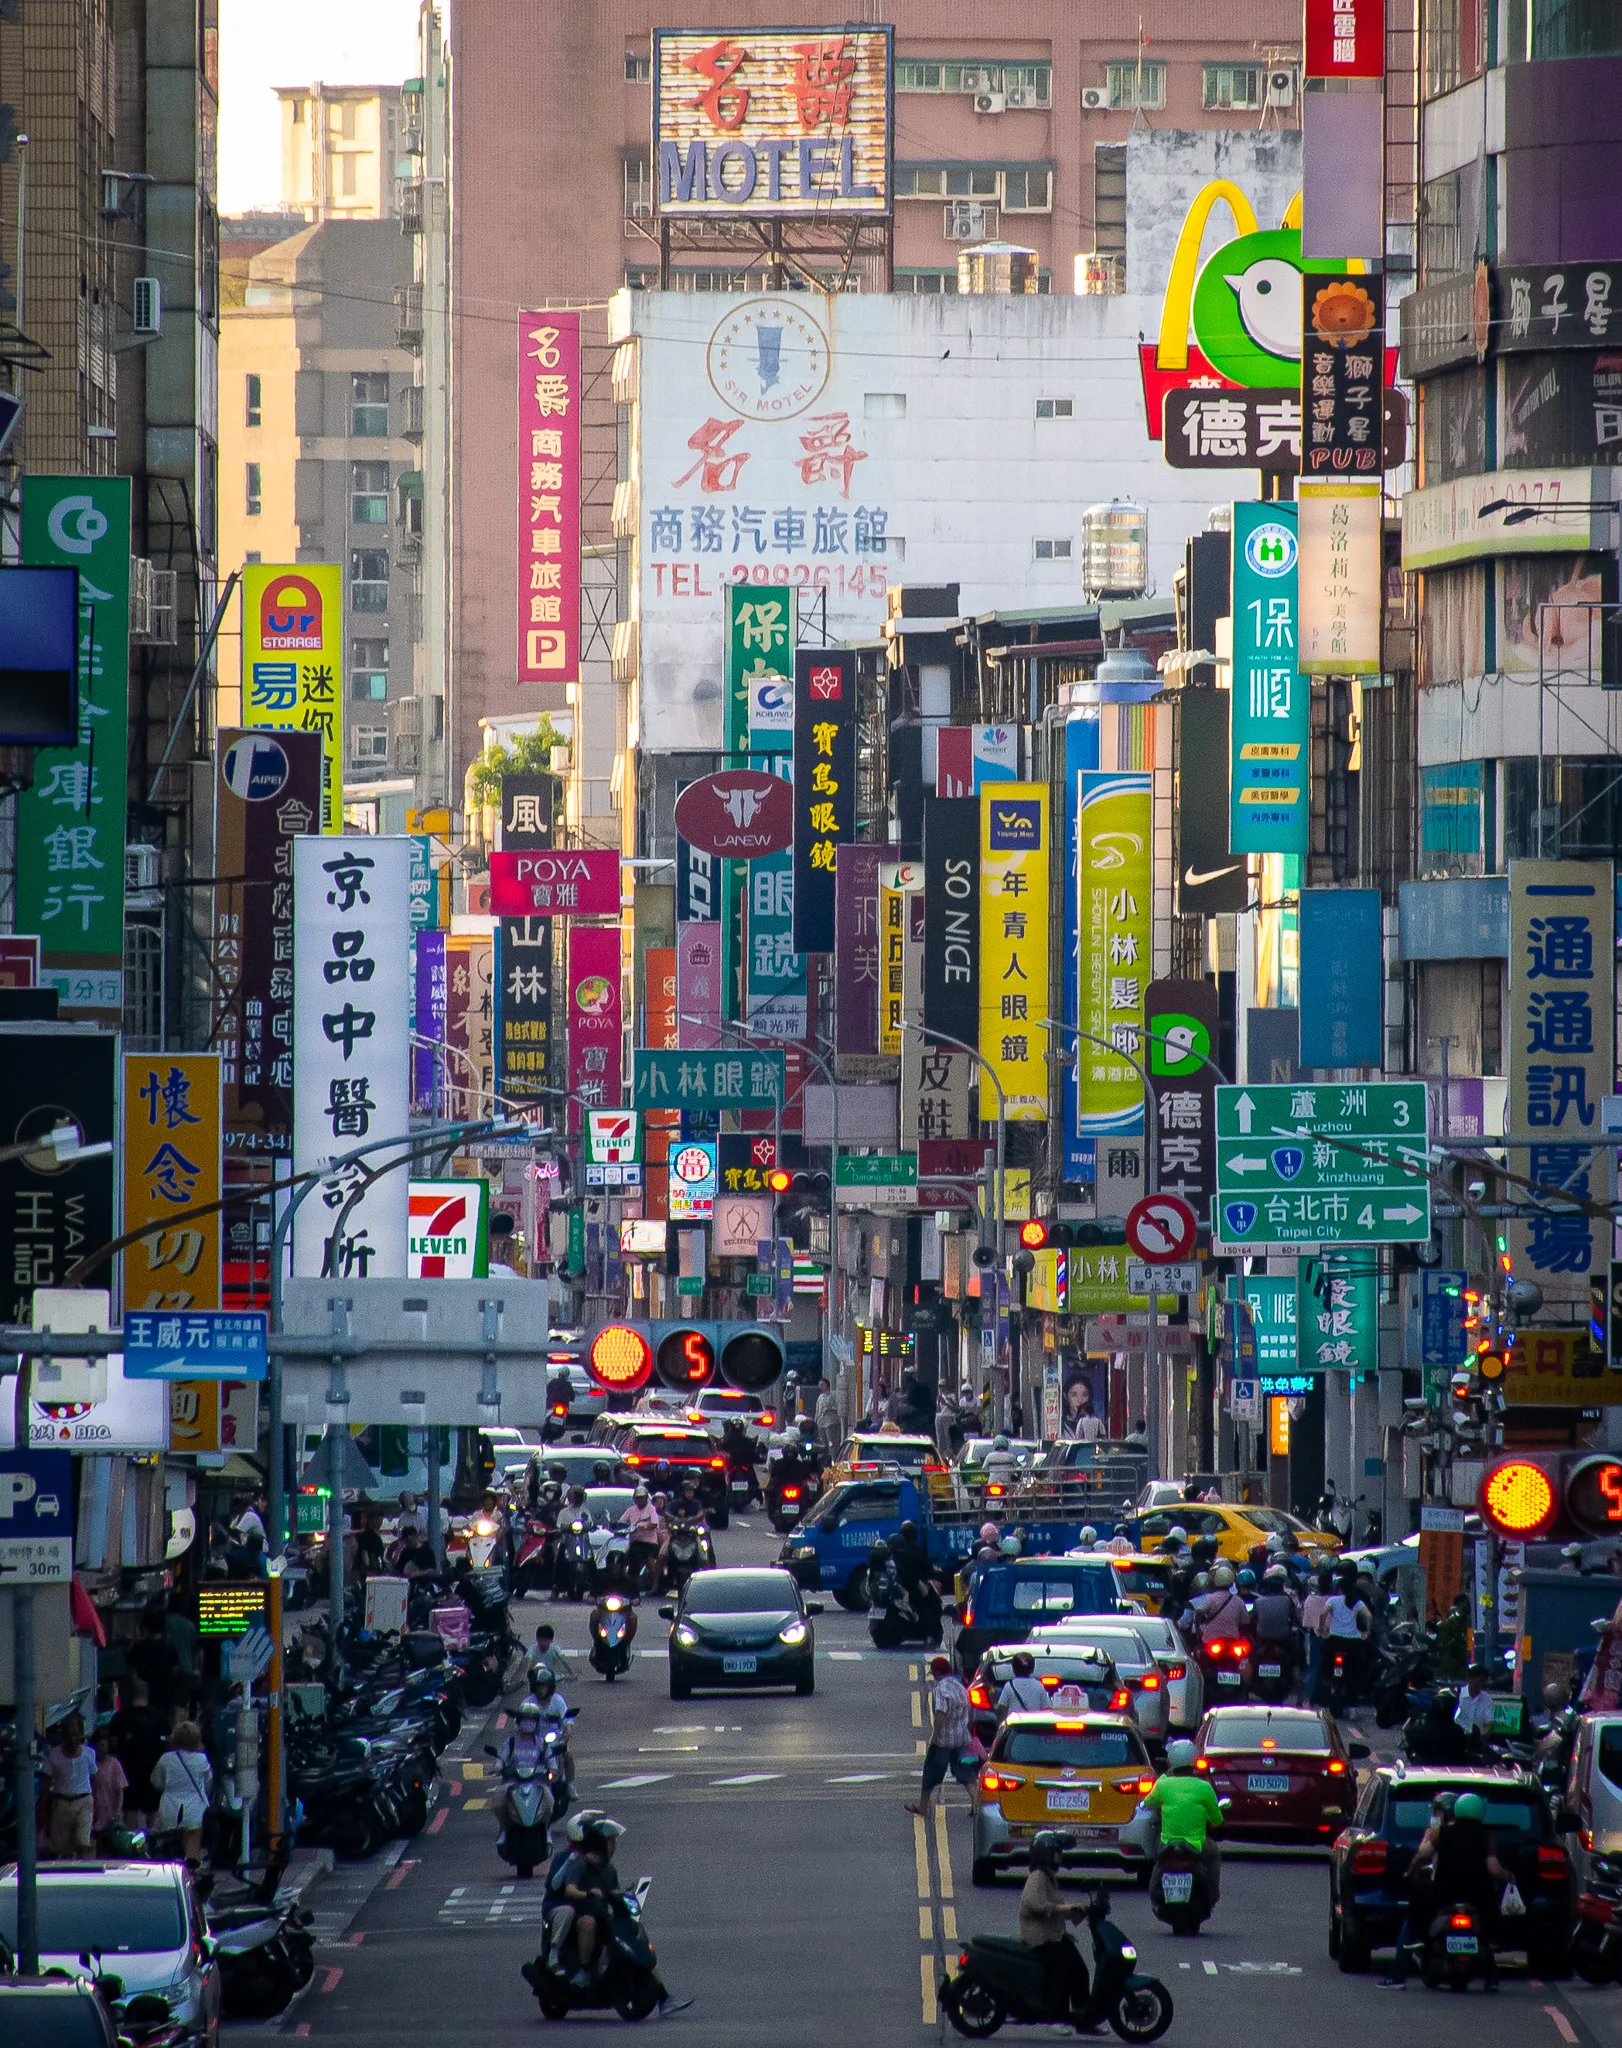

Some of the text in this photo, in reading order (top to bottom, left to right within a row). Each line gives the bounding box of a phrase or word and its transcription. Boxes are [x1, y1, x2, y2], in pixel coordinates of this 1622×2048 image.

[660, 137, 876, 203] MOTEL
[1509, 271, 1613, 340] 獅子星
[722, 379, 815, 412] SIR MOTEL
[1311, 352, 1336, 443] 音樂運動
[1344, 355, 1374, 441] 獅子星
[1181, 398, 1302, 458] 德克
[526, 326, 572, 623] 名爵商務汽車旅館
[1309, 447, 1377, 470] PUB
[650, 504, 889, 554] 商務汽車旅館
[262, 636, 323, 649] STORAGE
[808, 721, 841, 872] 寶島眼鏡
[713, 834, 771, 848] LANEW
[516, 857, 591, 881] POYA
[506, 795, 548, 1004] 風山林
[945, 858, 971, 985] SO NICE
[1000, 869, 1029, 1063] 年青人眼鏡
[1109, 887, 1140, 1056] 小林髮廊
[578, 1017, 614, 1029] POYA
[321, 851, 376, 1279] 京品中醫診所
[637, 1061, 783, 1098] 小林眼鏡
[1290, 1089, 1367, 1118] 蘆洲
[1393, 1100, 1410, 1127] 3
[1306, 1121, 1352, 1132] Luzhou
[1317, 1173, 1384, 1184] Xinzhuang
[1264, 1194, 1349, 1223] 台北市
[1357, 1204, 1376, 1230] 4
[1276, 1226, 1341, 1239] Taipei City
[1144, 1267, 1182, 1280] 6-23
[128, 1317, 211, 1349] 王威元
[683, 1332, 708, 1380] 5
[29, 1562, 61, 1576] 30m
